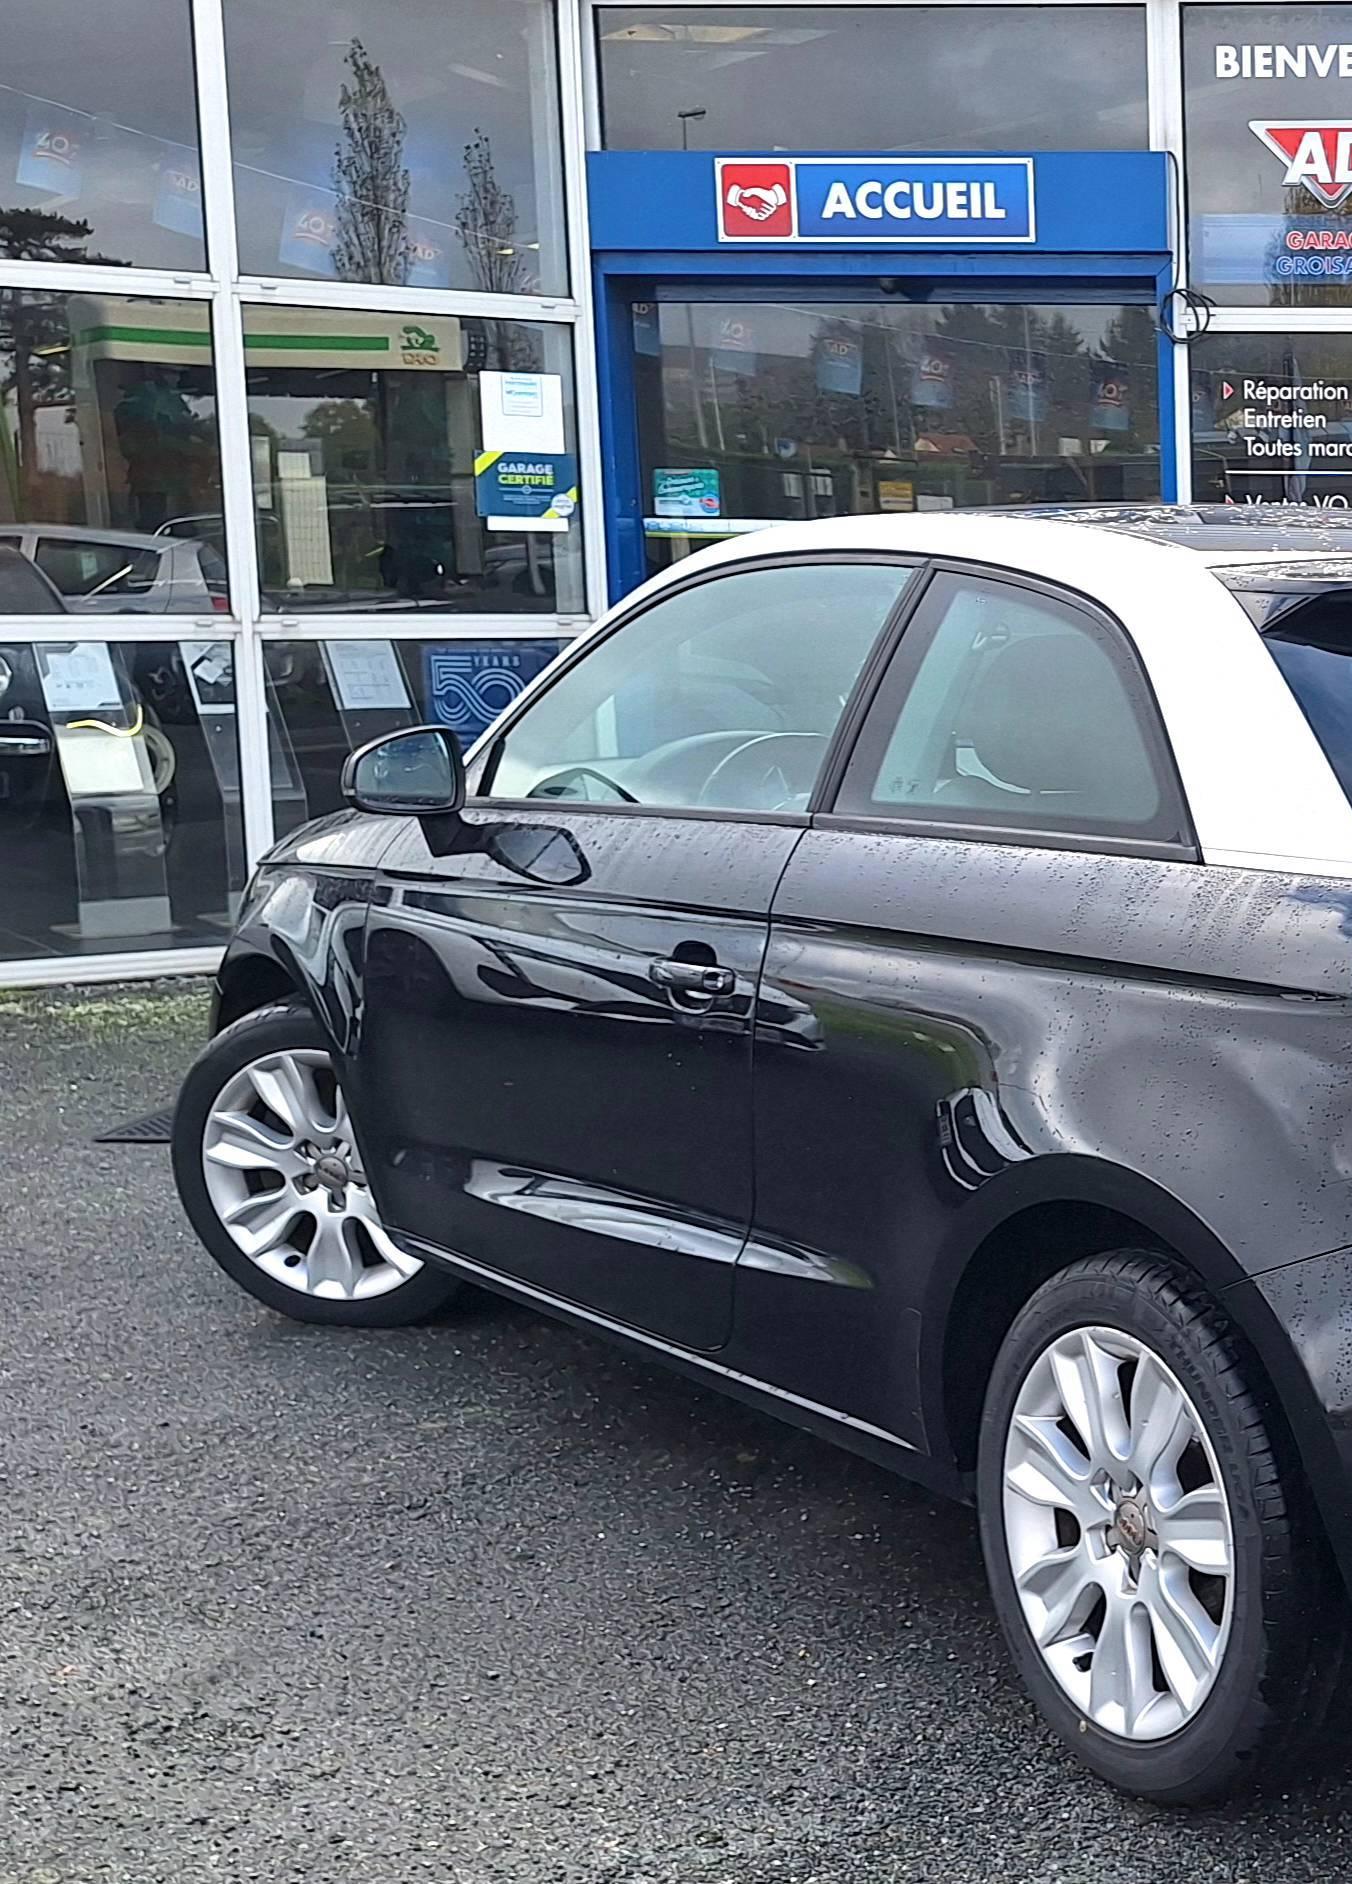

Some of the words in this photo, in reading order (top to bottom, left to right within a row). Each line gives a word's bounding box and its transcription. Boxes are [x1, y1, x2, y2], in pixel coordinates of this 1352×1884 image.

[821, 181, 1006, 219] ACCUEIL
[1244, 380, 1349, 405] Réparation
[1244, 408, 1326, 428] Entretien
[1243, 437, 1302, 456] Toutes
[497, 462, 554, 475] GARAGE
[473, 656, 521, 668] YEARS
[431, 655, 526, 725] 50
